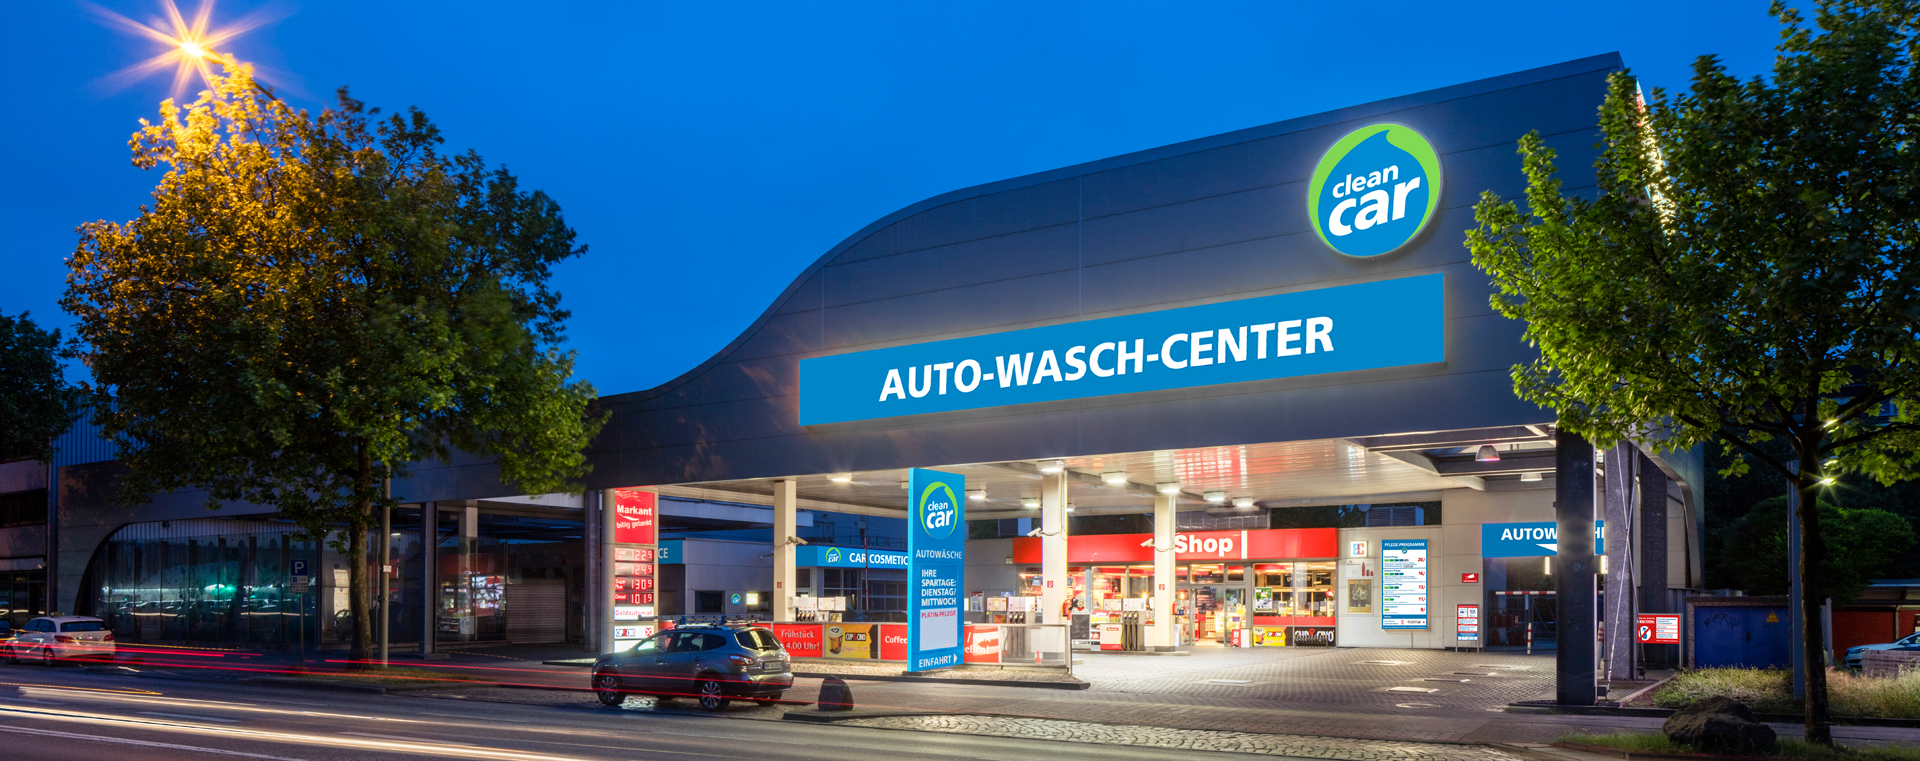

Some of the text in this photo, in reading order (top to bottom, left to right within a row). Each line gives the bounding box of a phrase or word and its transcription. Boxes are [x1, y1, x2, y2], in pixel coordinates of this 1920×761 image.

[1332, 164, 1399, 198] clean
[1328, 176, 1420, 236] car
[878, 316, 1334, 402] AUTO-WASCH-CENTER
[616, 504, 652, 516] Markant
[928, 500, 948, 511] clean
[616, 520, 652, 529] billig getankt
[926, 510, 953, 529] car
[1175, 535, 1234, 557] Shop
[849, 553, 866, 563] CAR
[916, 549, 962, 559] AUTOWÄSCHE
[295, 561, 304, 574] P
[921, 569, 937, 577] IHRE
[921, 579, 956, 587] SPARTAGE:
[921, 588, 956, 596] DIENSTAG/
[921, 598, 956, 606] MITTWOCH
[781, 629, 814, 638] Frühstück
[885, 635, 907, 644] Coffee
[803, 642, 820, 650] Uhr!
[919, 655, 951, 668] EINFAHRT
